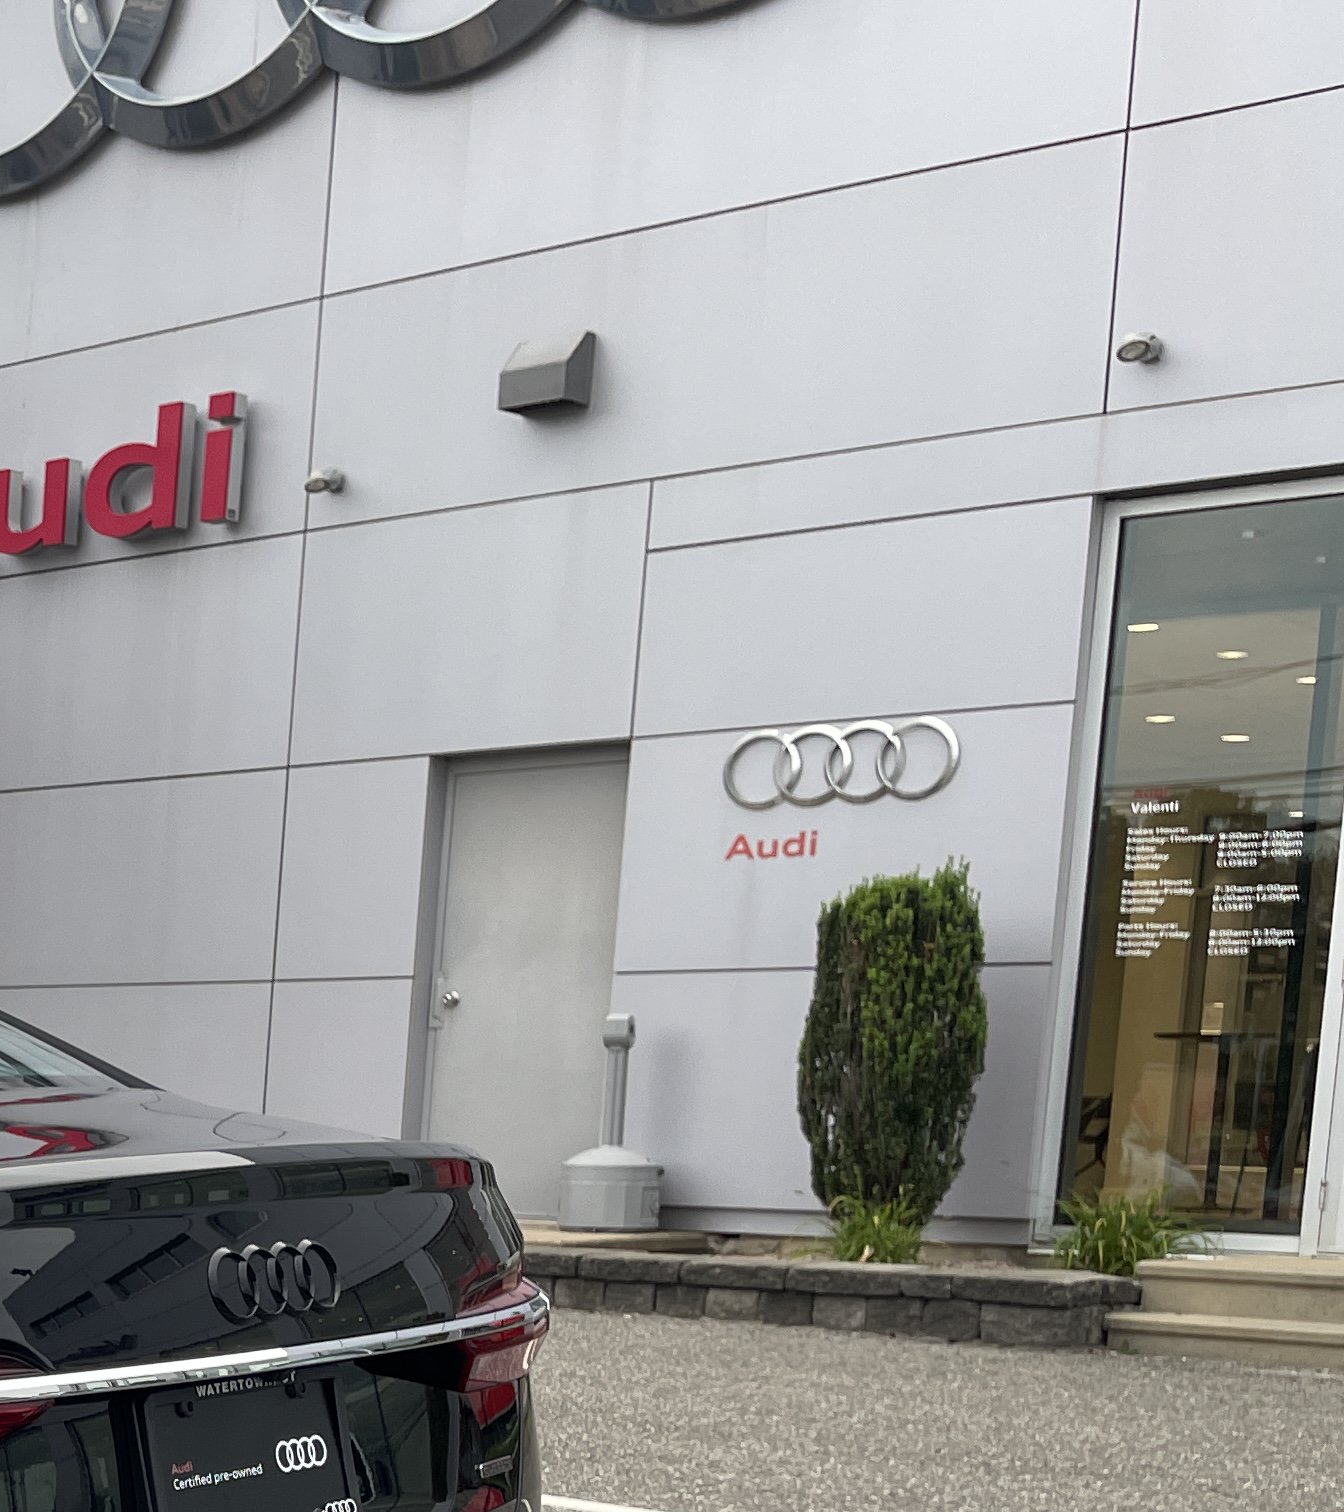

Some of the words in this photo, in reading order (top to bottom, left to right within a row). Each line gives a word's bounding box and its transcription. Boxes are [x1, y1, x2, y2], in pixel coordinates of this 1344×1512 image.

[1131, 800, 1179, 814] Valenti
[725, 830, 819, 861] Audi
[172, 1461, 193, 1475] Audi
[173, 1473, 213, 1491] Certified
[214, 1463, 264, 1485] pre-owned
